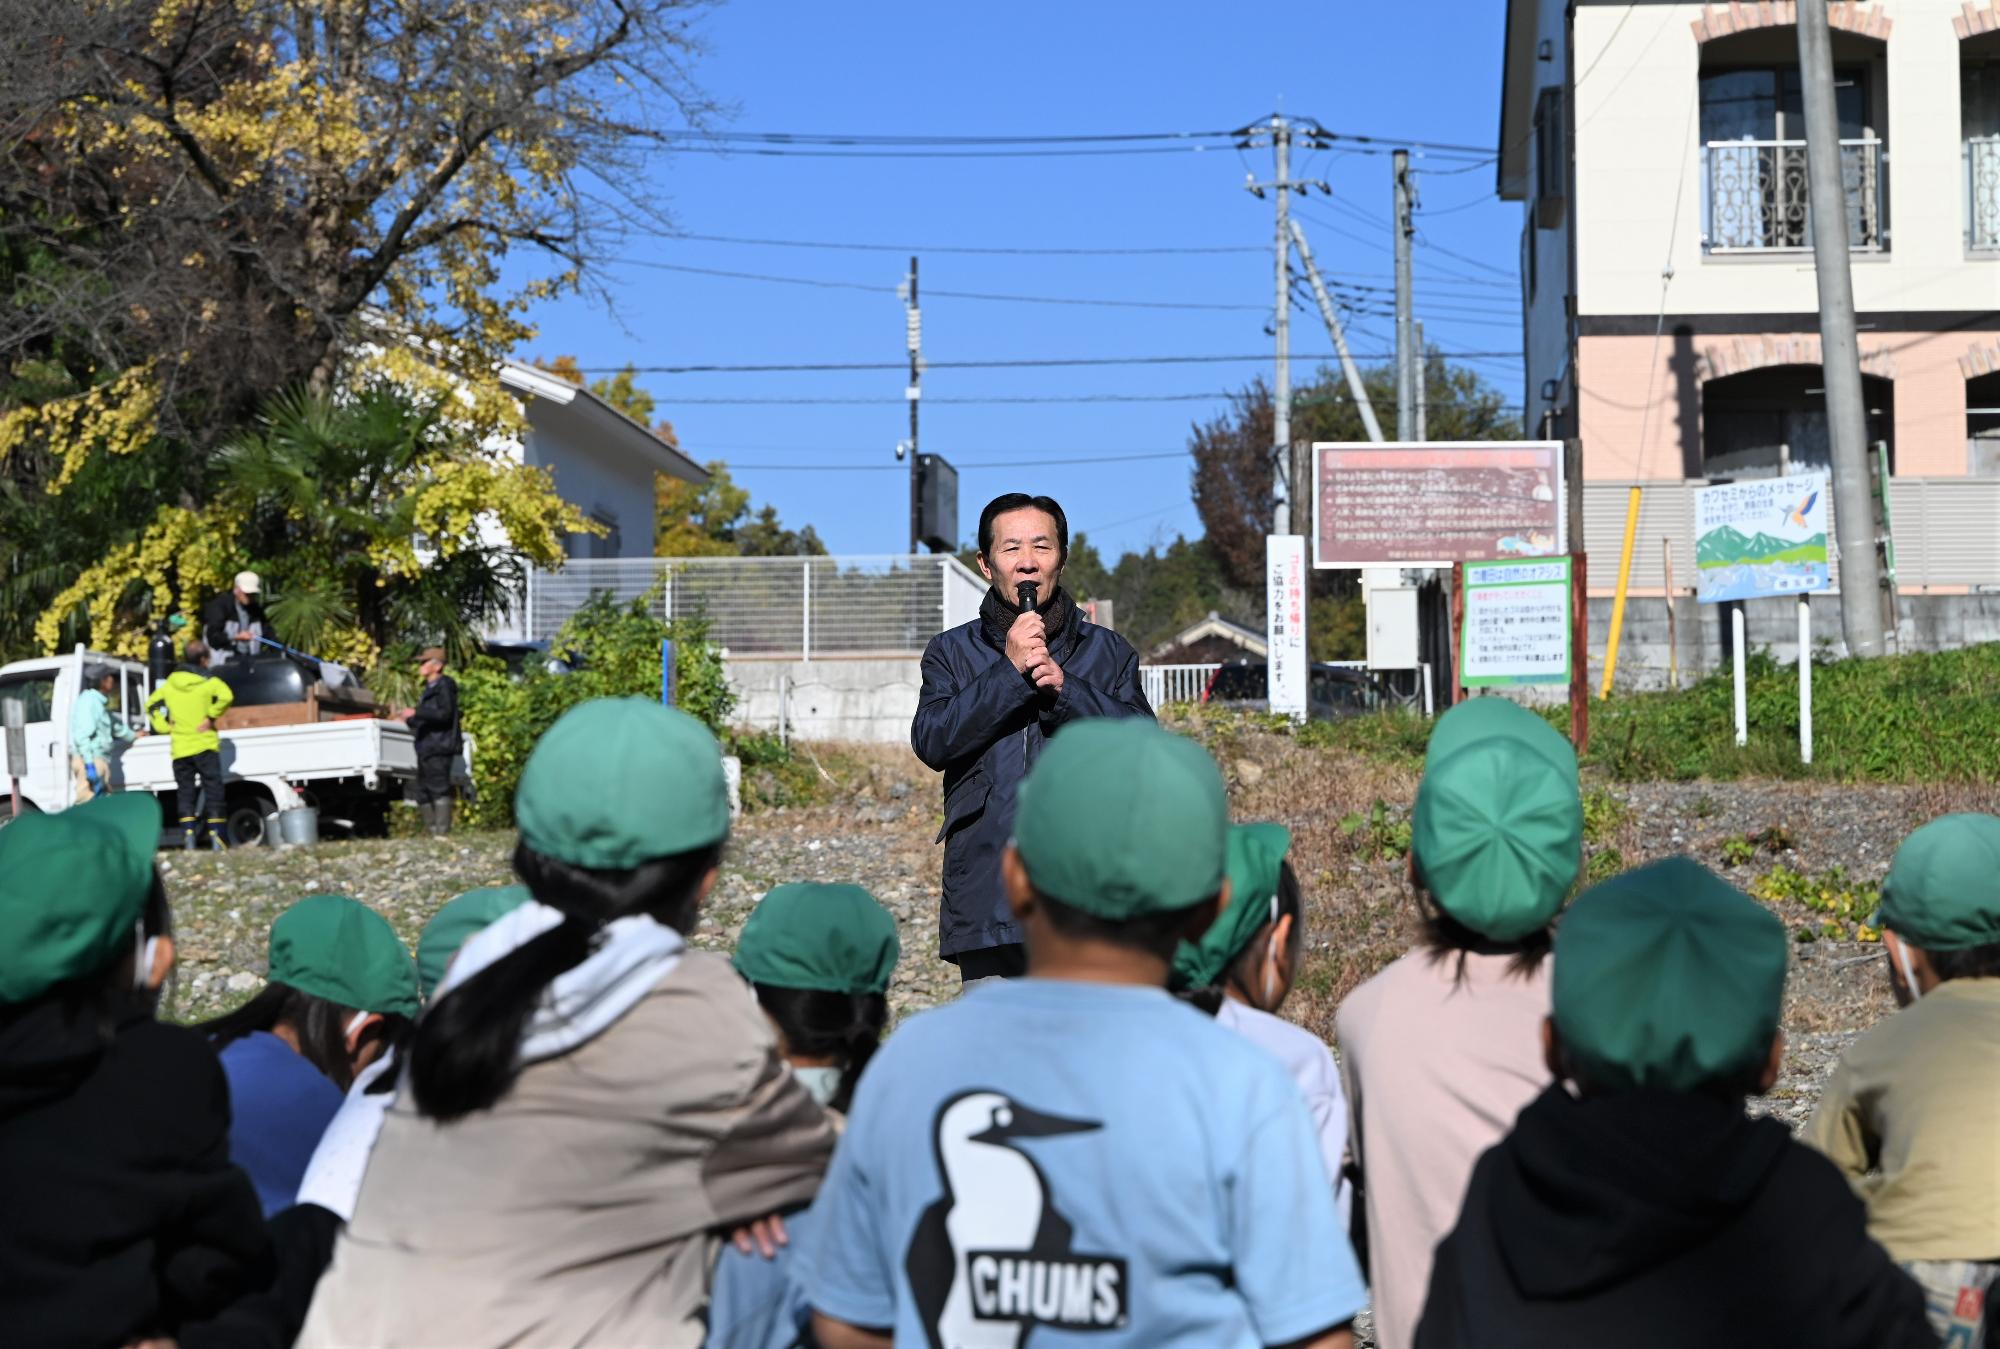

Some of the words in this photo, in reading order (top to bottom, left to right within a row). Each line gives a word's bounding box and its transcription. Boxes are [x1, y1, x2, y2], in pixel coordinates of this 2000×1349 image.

[1703, 479, 1814, 504] カワセミからのメッセージ
[1289, 553, 1301, 648] ゴミの持ち帰りに
[972, 1255, 1119, 1325] CHUMS
